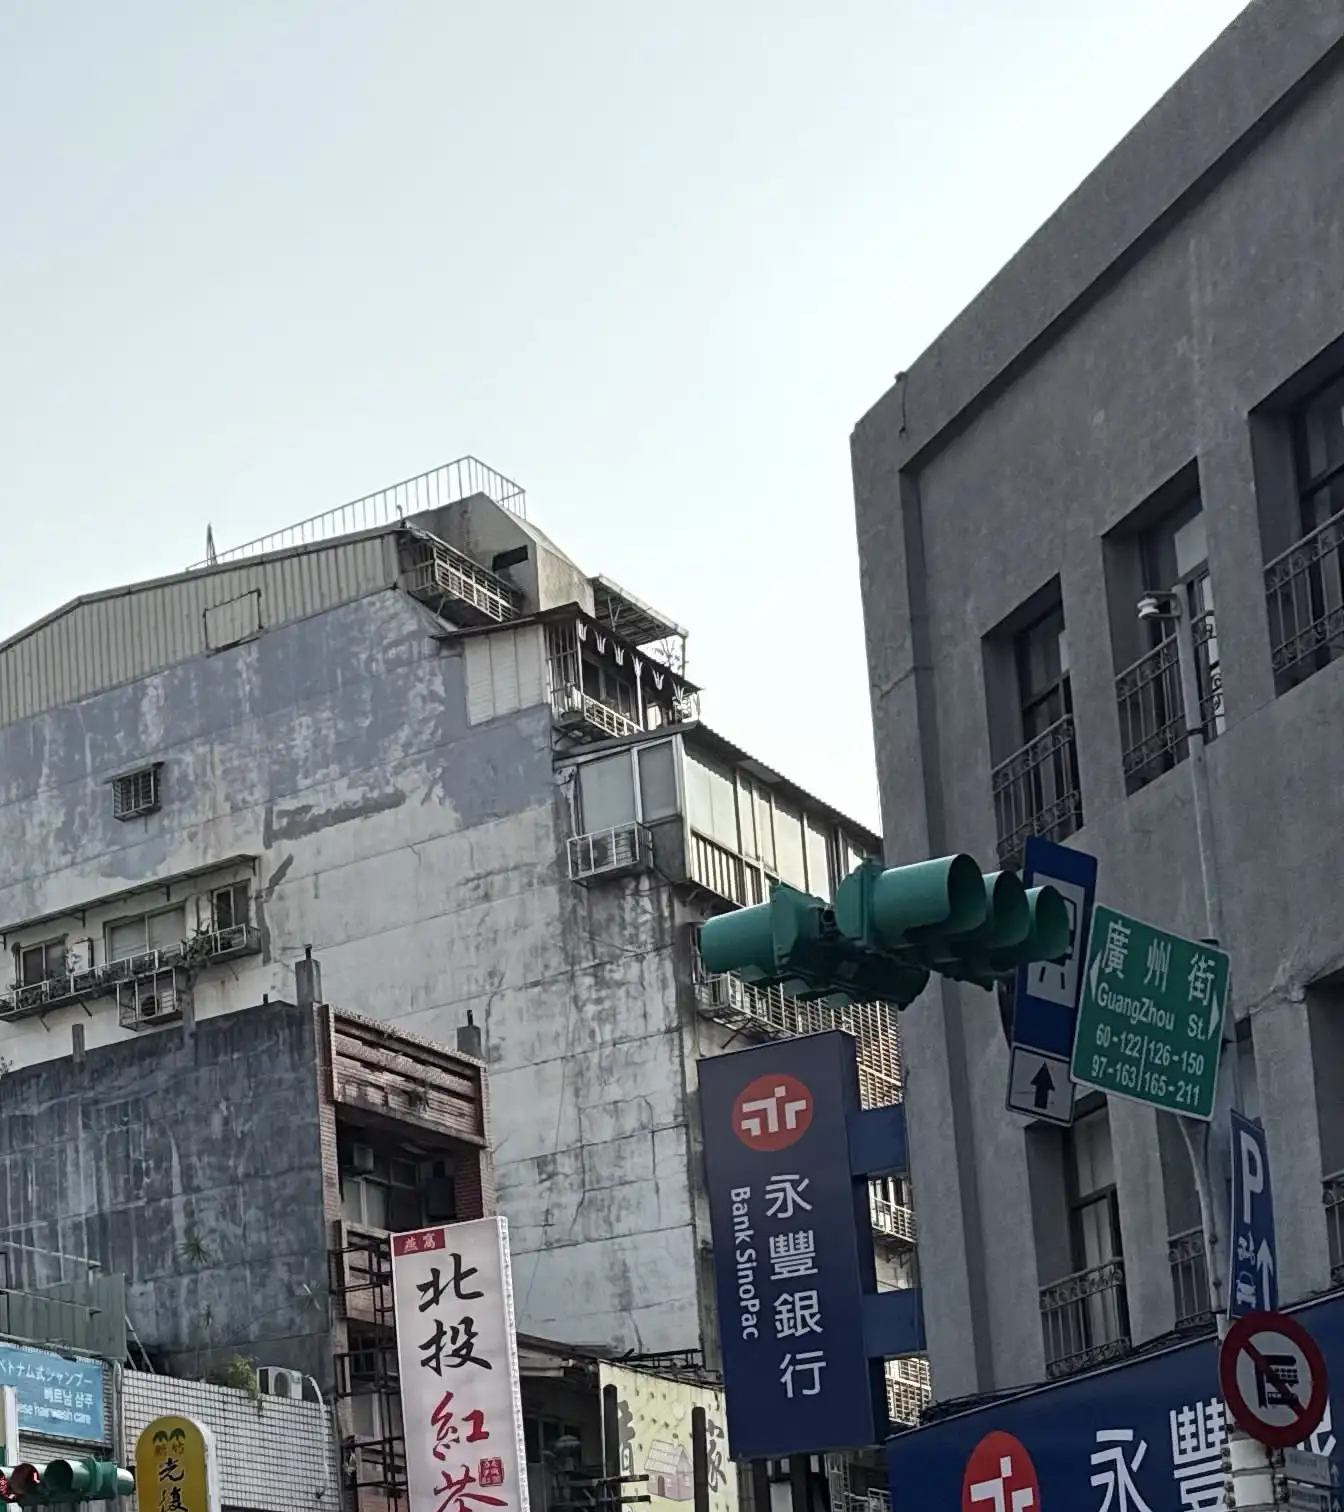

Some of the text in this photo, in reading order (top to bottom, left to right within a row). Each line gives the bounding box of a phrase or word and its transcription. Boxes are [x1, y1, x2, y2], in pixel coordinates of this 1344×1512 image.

[1101, 919, 1216, 1006] 廣州街
[1096, 1023, 1205, 1076] 60-122 126-150
[1097, 981, 1206, 1040] GuangZhou St.
[1091, 1054, 1200, 1107] 97-163 165-211
[1239, 1130, 1264, 1225] P
[730, 1185, 762, 1341] Bank SinoPac
[764, 1174, 827, 1399] 永豐銀行
